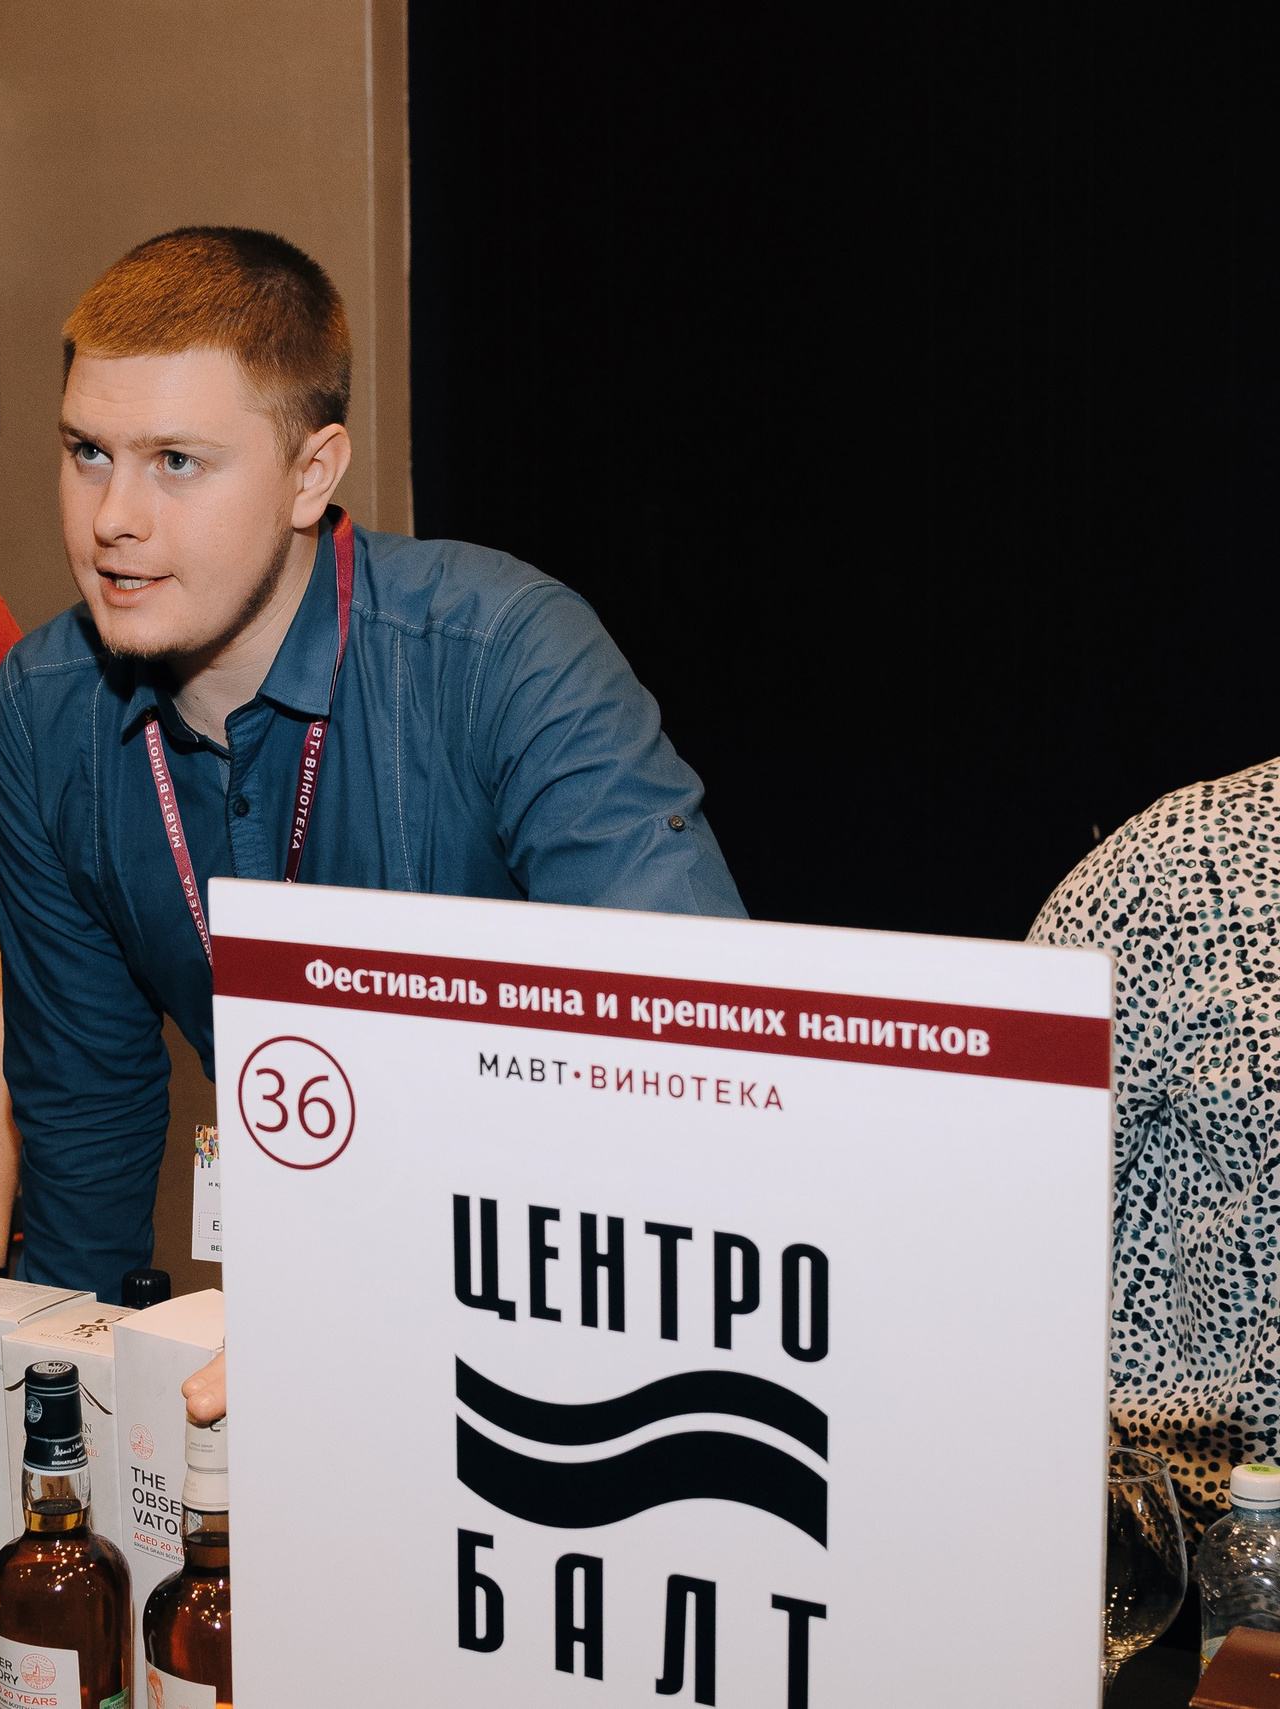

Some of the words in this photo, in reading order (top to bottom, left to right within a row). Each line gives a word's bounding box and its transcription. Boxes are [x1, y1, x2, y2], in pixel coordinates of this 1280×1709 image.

[304, 959, 487, 1005] Фестиваль
[498, 982, 585, 1016] вина
[596, 992, 618, 1019] и
[630, 996, 787, 1035] крепких
[798, 1011, 991, 1057] напитков
[256, 1068, 336, 1139] 36
[453, 1193, 829, 1363] ЦЕНТРО
[131, 1466, 166, 1492] THE
[132, 1487, 181, 1516] OBSE
[133, 1506, 182, 1538] VATO
[134, 1532, 157, 1547] AGED
[160, 1541, 171, 1551] 20
[458, 1527, 828, 1709] БАЛТ
[3, 1689, 14, 1699] 20
[16, 1693, 58, 1706] YEARS
